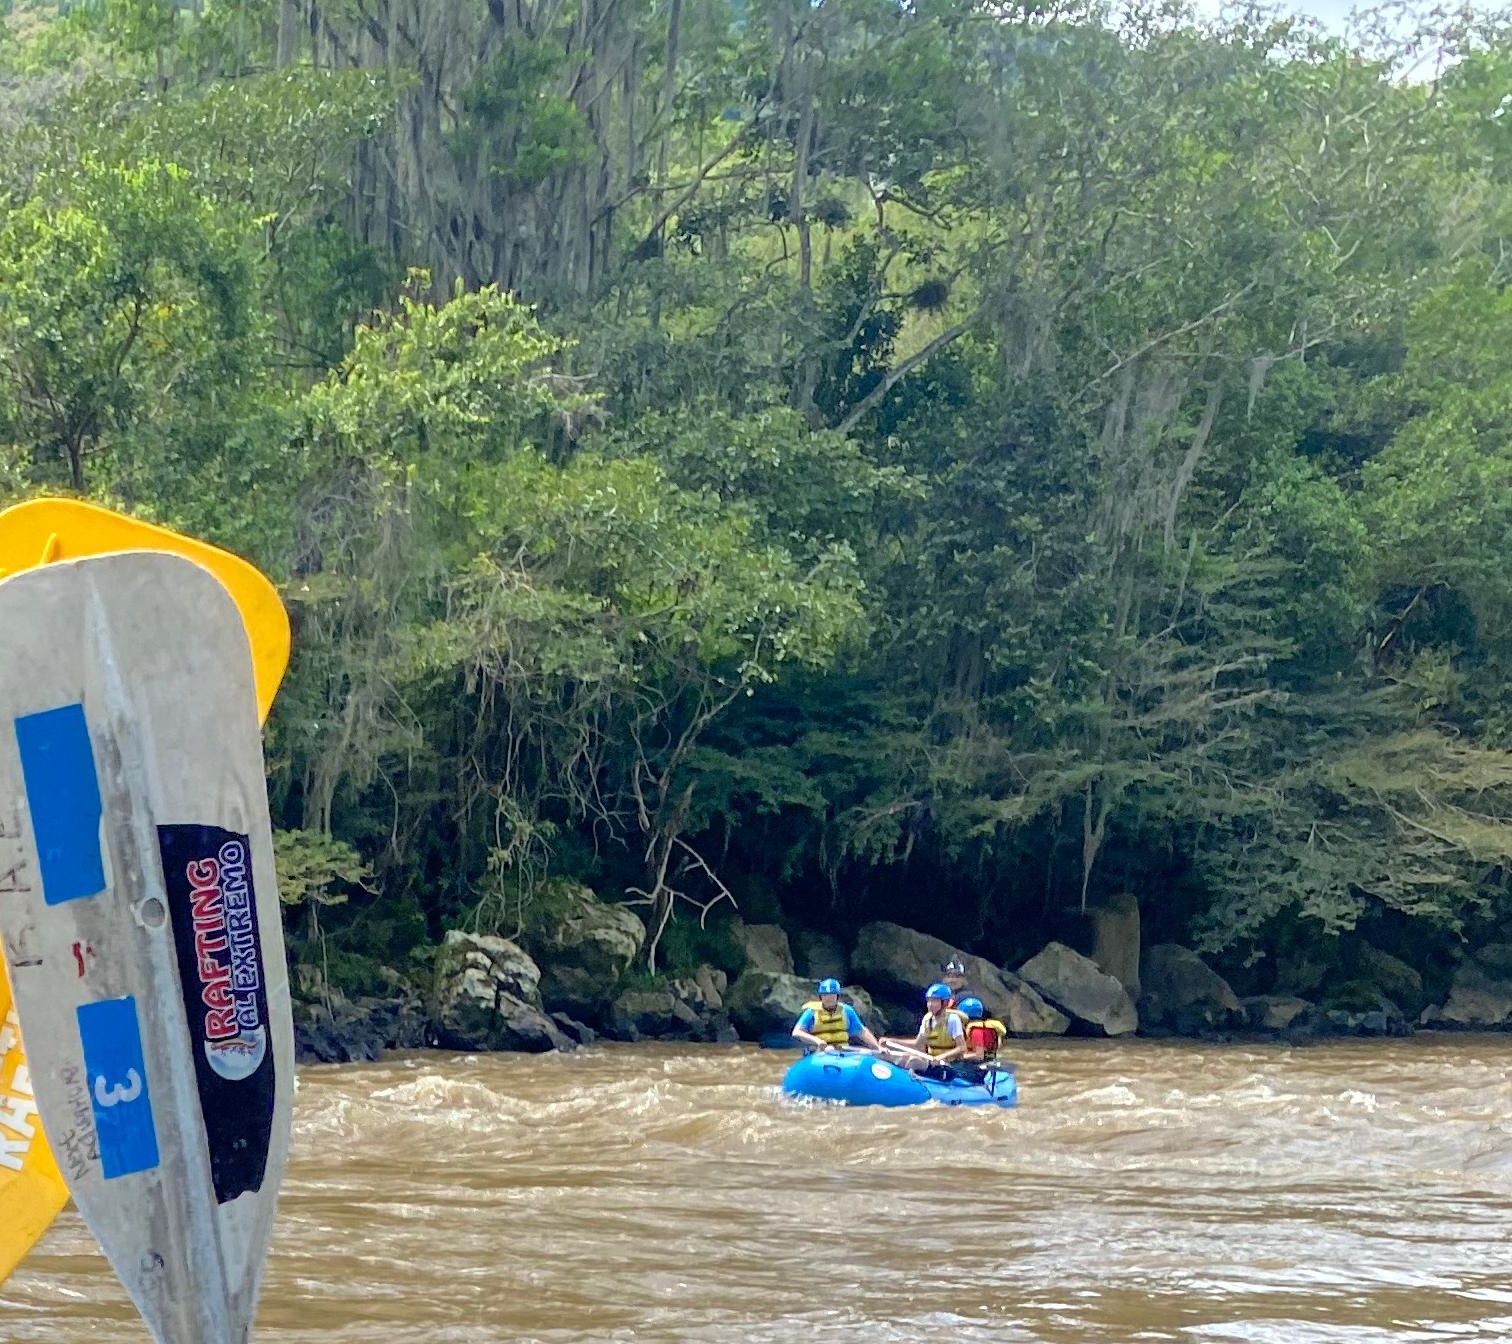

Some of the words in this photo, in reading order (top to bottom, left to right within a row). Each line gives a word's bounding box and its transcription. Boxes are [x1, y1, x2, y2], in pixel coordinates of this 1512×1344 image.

[185, 858, 238, 1042] RAFTING
[221, 840, 260, 992] EXTREMO
[233, 985, 260, 1031] AL
[95, 1067, 143, 1107] 3
